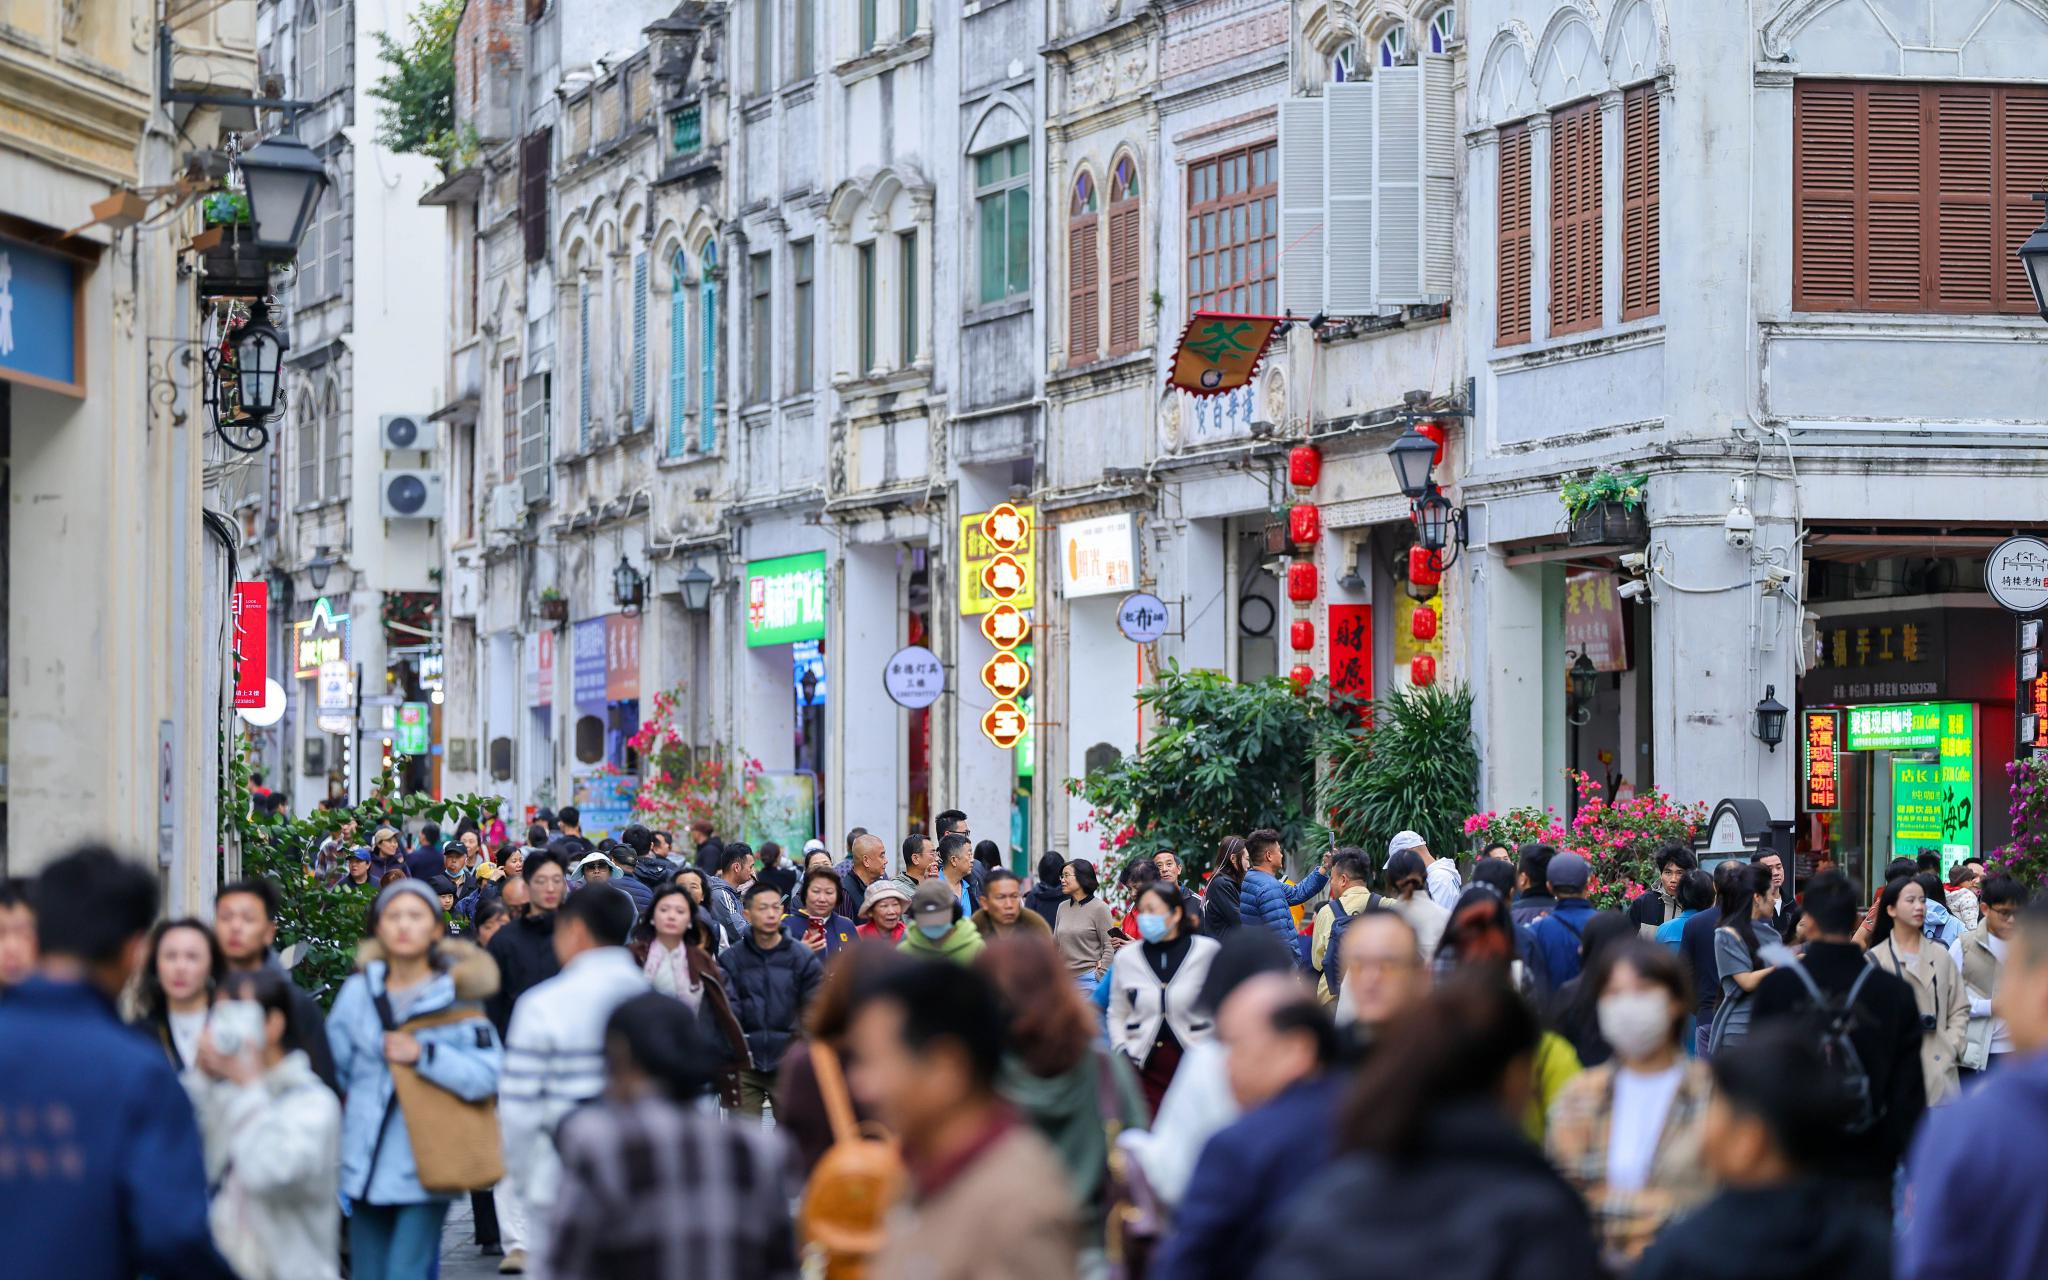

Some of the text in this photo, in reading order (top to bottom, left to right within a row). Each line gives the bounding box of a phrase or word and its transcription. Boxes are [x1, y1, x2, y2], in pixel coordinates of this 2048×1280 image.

[1851, 709, 1913, 734] 聚福现磨咖啡
[1809, 715, 1835, 807] 聚福现磨咖啡
[1901, 769, 1940, 783] 店长
